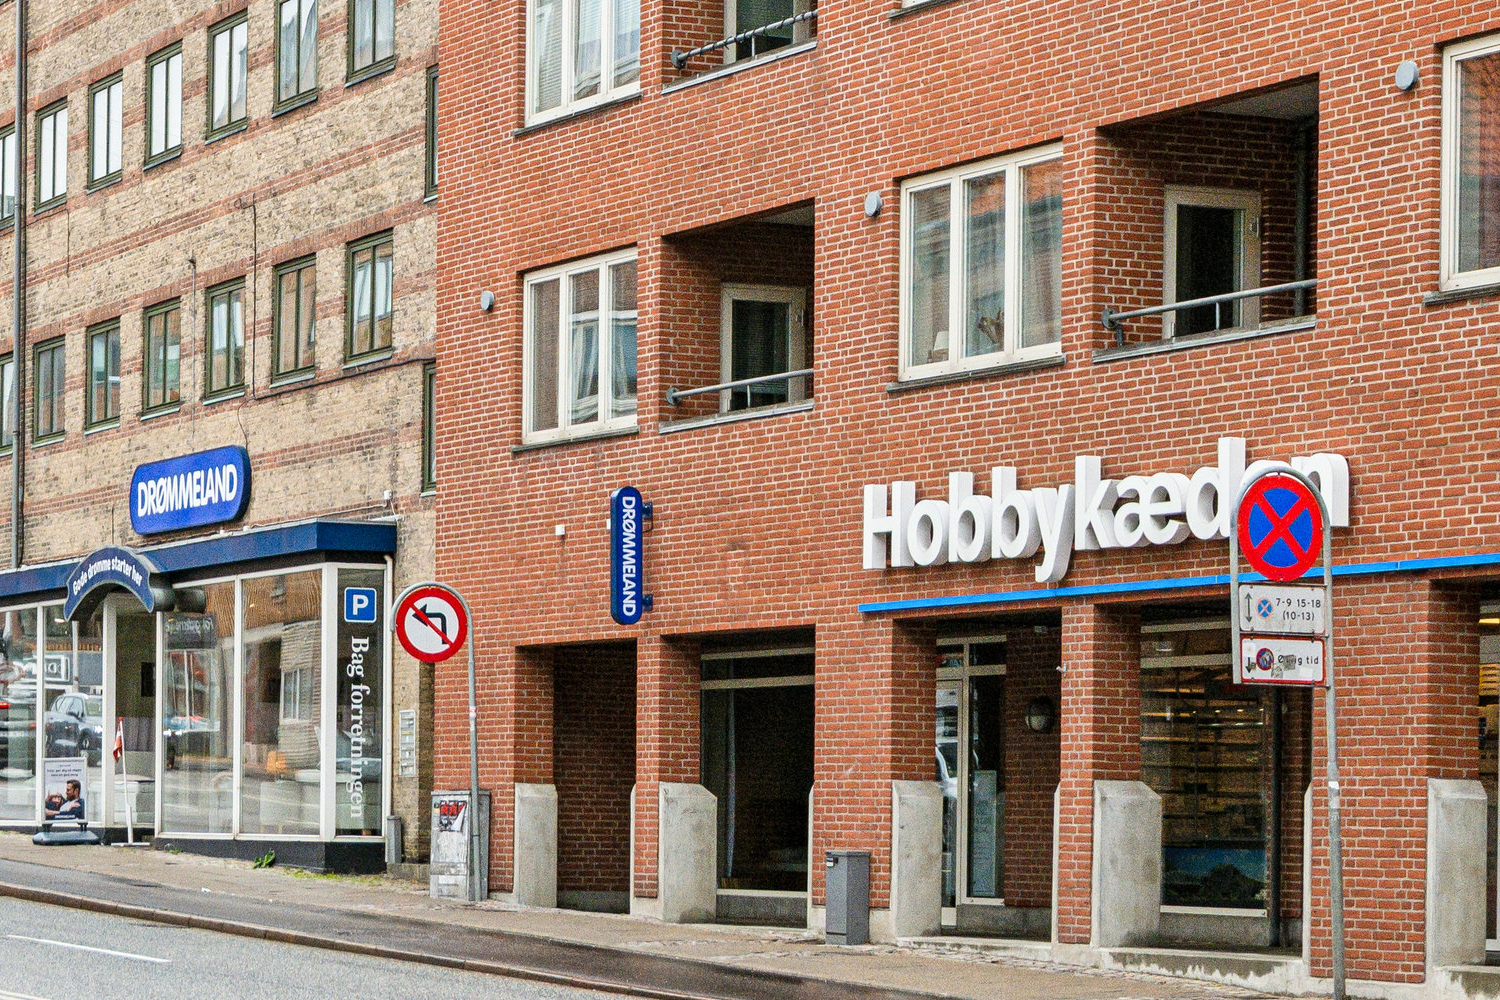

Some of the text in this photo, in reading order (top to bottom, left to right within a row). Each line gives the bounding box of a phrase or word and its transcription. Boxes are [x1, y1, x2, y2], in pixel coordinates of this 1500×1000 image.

[136, 462, 238, 518] DRØMMELAND
[622, 496, 637, 617] DRØMMELAND
[72, 555, 143, 596] Gode drømme starter her
[352, 594, 369, 616] P
[1275, 597, 1321, 608] 7-9 15-18
[1282, 610, 1315, 621] (10-13)
[1277, 654, 1319, 666] Øig tid
[346, 635, 370, 818] Bag forretningen
